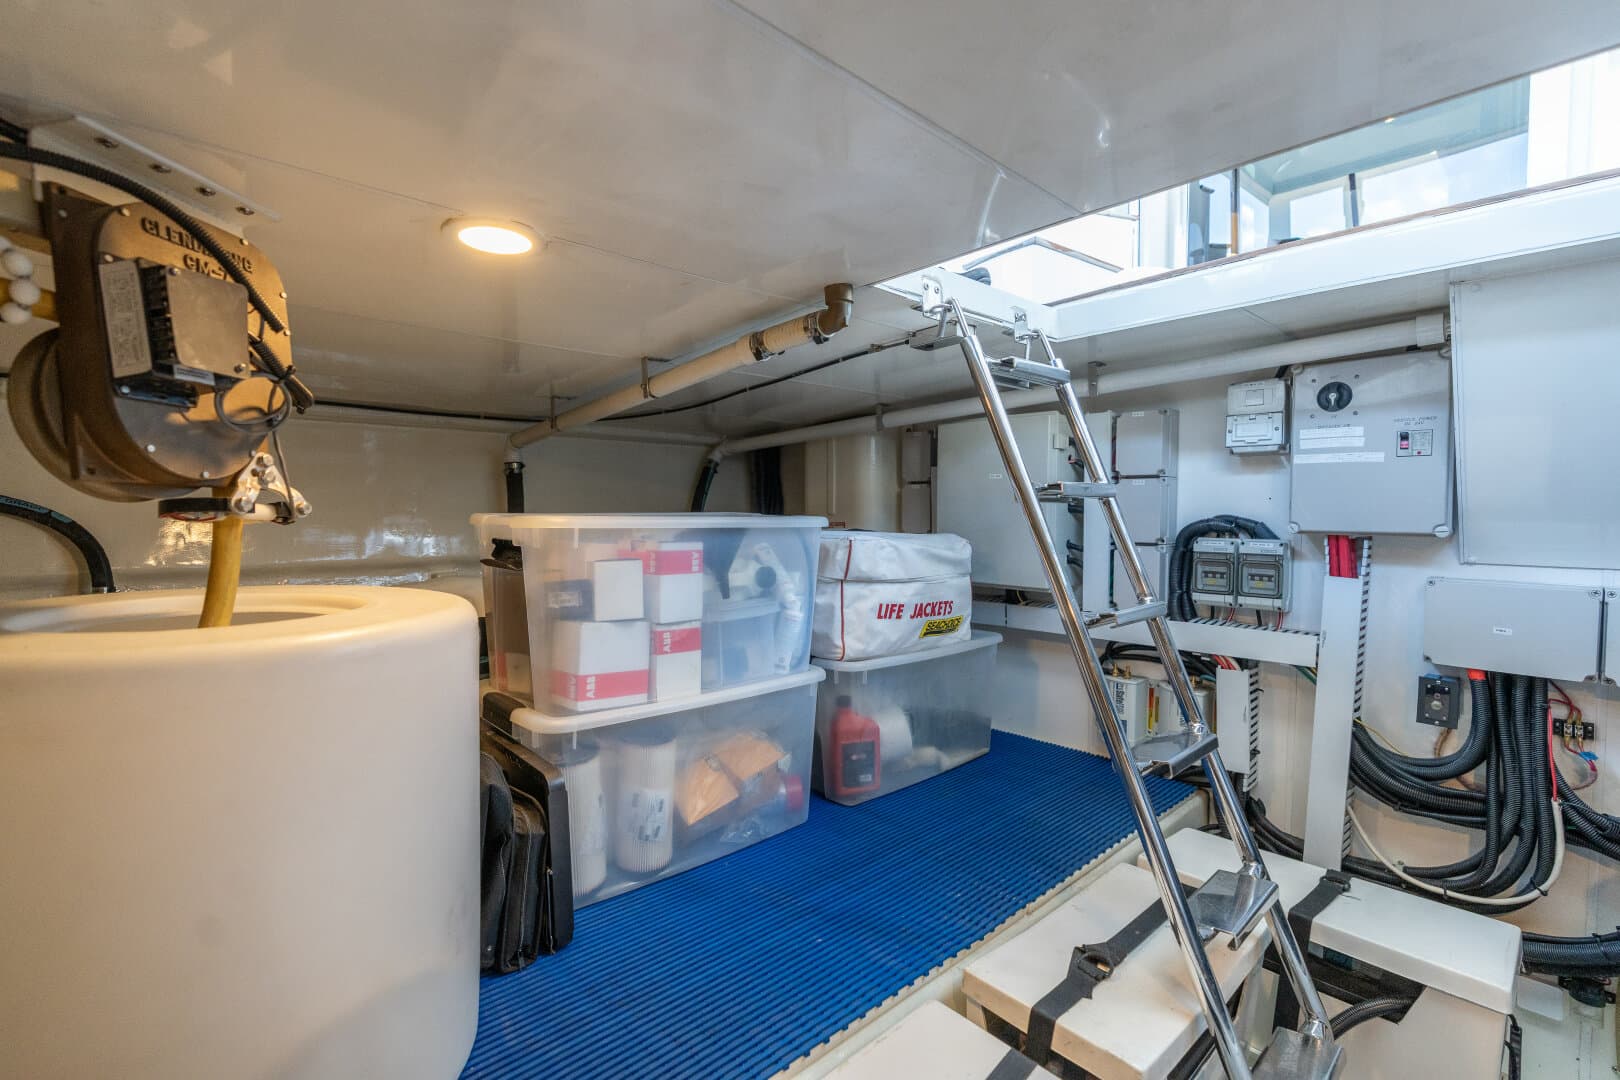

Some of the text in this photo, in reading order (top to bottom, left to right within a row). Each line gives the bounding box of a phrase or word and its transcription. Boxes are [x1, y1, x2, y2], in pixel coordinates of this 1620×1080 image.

[691, 551, 700, 572] ABB
[877, 600, 953, 619] LIFE JACKETS
[662, 631, 672, 655] ABB
[585, 676, 596, 699] ABB
